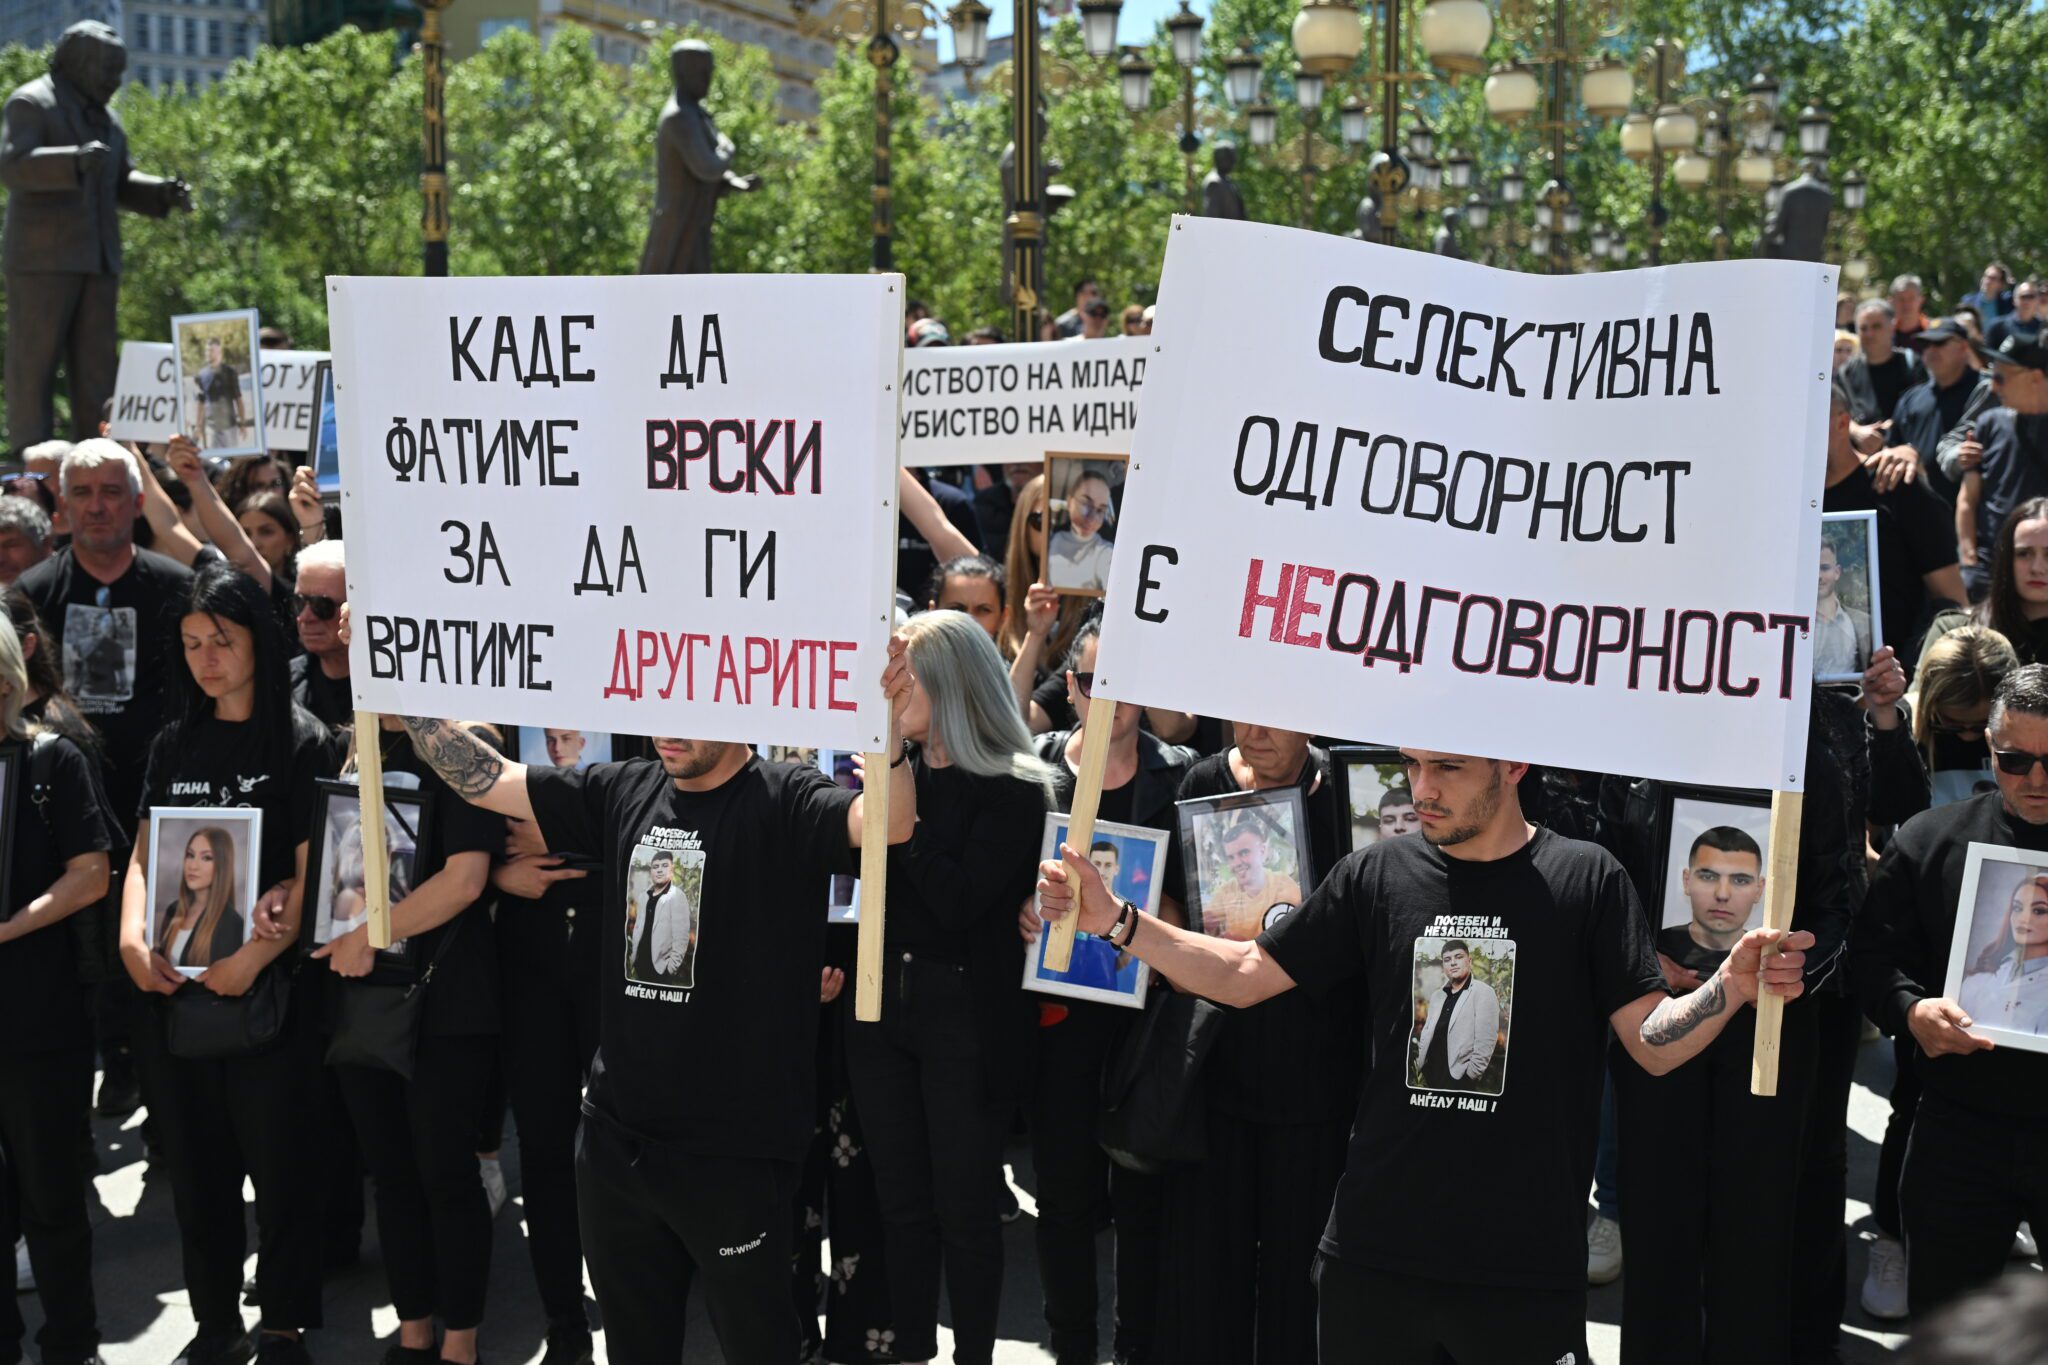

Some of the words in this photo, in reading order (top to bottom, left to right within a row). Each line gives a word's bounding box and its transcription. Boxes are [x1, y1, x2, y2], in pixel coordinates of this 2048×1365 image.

[449, 315, 595, 388] КАДЕ
[660, 314, 727, 389] ДА
[1027, 362, 1063, 391] НА
[1318, 286, 1720, 400] СЕЛЕКТИВНА
[386, 416, 579, 486] ФАТИМЕ
[646, 418, 822, 495] ВРСКИ
[901, 405, 1019, 439] УБИСТВО
[1028, 404, 1064, 434] НА
[1233, 415, 1691, 544] ОДГОВОРНОСТ
[441, 520, 511, 587] ЗА
[573, 524, 647, 597] ДА
[704, 528, 776, 600] ГИ
[366, 615, 554, 691] ВРАТИМЕ
[603, 628, 858, 712] ДРУГАРИТЕ
[1238, 558, 1810, 700] НЕОДГОВОРНОСТ
[1423, 925, 1508, 939] НЕЗАБОРАВЕН
[1433, 915, 1489, 927] ПОСЕБЕН
[1491, 916, 1501, 927] И
[659, 988, 683, 1003] НАШ
[1457, 1097, 1488, 1112] НАШ
